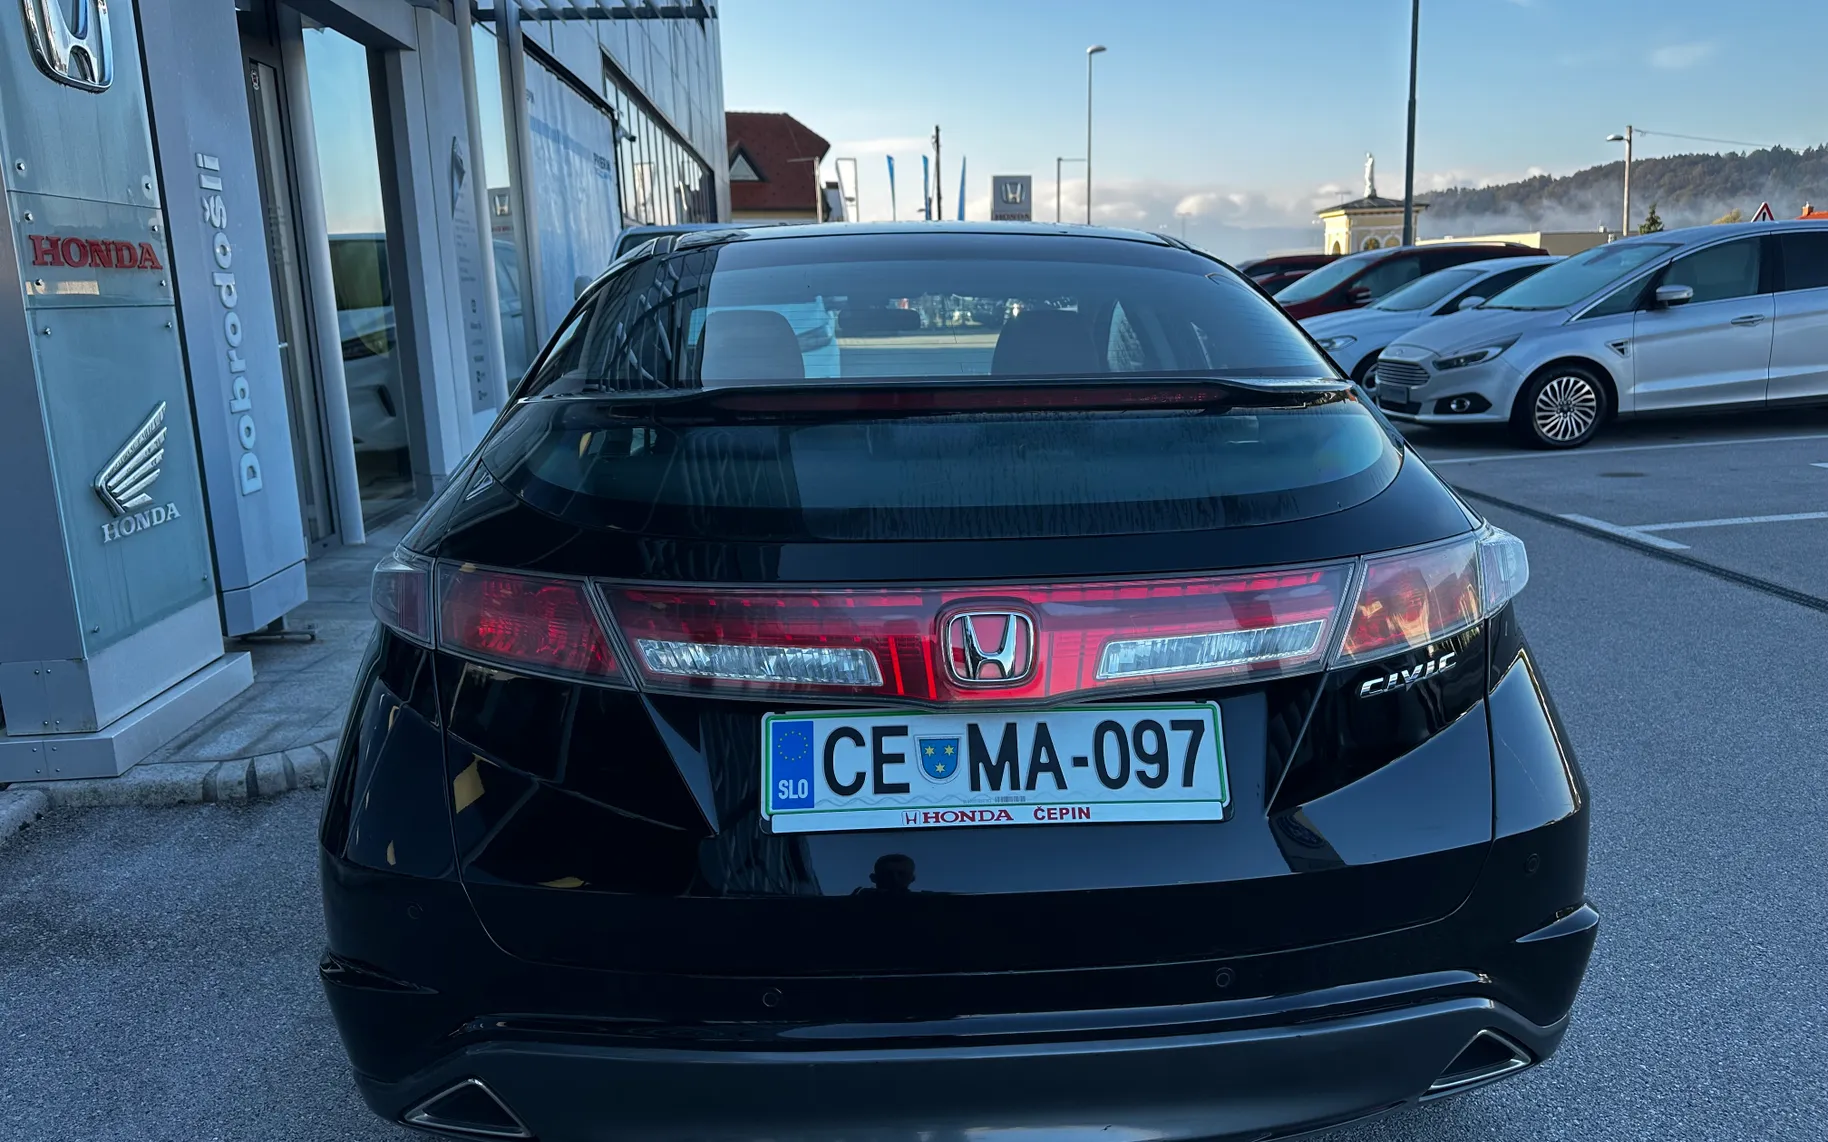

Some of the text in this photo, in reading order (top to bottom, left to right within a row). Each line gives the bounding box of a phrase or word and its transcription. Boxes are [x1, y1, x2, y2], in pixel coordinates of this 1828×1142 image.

[29, 235, 163, 269] HONDA
[195, 153, 262, 496] Dobrodošli
[101, 503, 181, 543] HONDA
[1360, 652, 1457, 698] CIVIC
[823, 719, 1206, 796] CE MA-097
[778, 778, 809, 800] SLO
[922, 805, 1091, 824] HONDA ČEPIN
